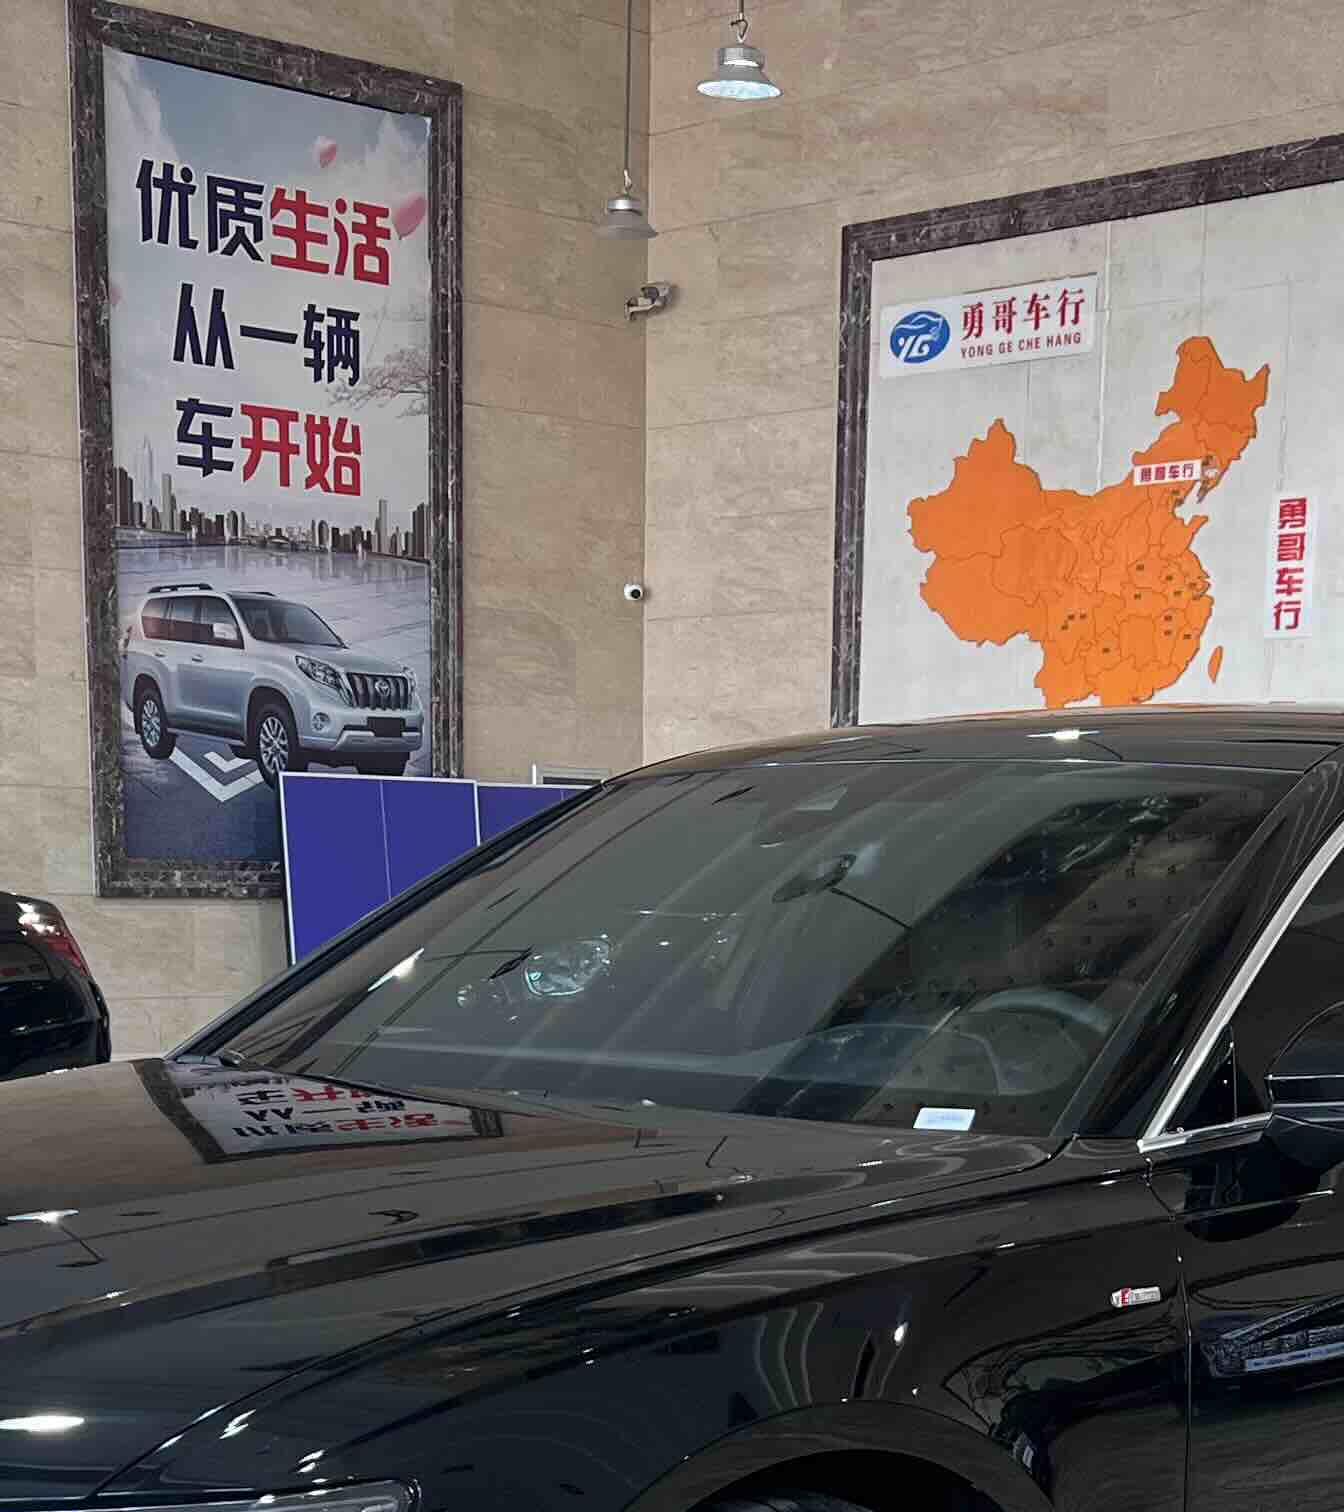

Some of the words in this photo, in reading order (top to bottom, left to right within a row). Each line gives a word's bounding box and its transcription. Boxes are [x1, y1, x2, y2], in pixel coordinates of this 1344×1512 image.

[135, 158, 392, 286] 优质生活
[172, 282, 361, 387] 从一辆
[960, 287, 1086, 341] 勇哥车行
[960, 343, 993, 359] YONG
[998, 341, 1013, 355] GE
[1018, 337, 1041, 352] CHE
[1045, 331, 1082, 347] HANG
[175, 398, 363, 497] 车开始
[1273, 497, 1307, 631] 勇哥车行
